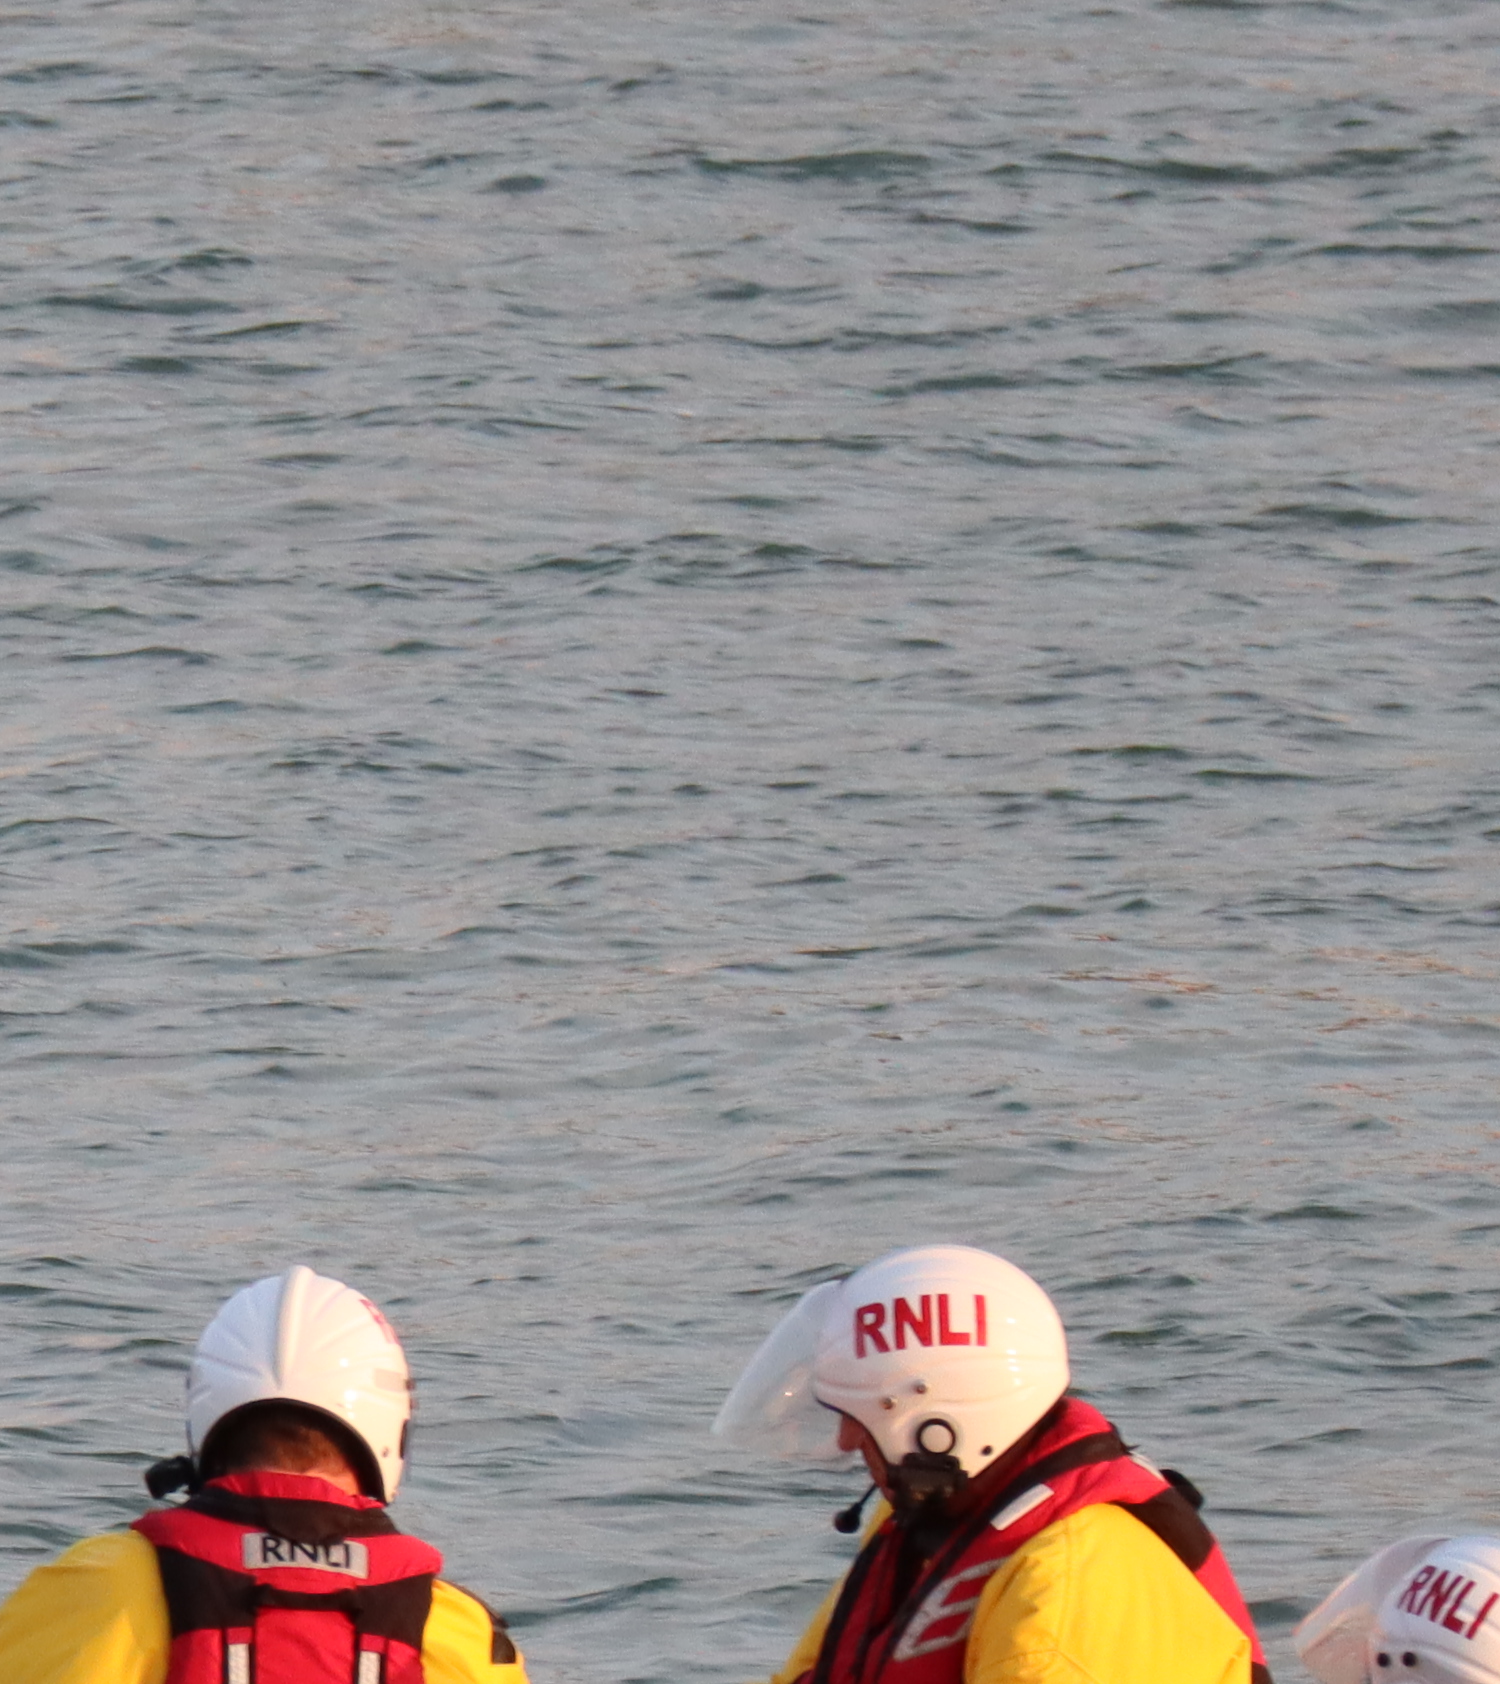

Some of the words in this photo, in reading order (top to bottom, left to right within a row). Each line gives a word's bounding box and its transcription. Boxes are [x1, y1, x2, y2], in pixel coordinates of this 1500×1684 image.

[856, 1290, 987, 1359] RNLI
[261, 1536, 351, 1569] RNLI
[1397, 1565, 1500, 1640] RNLI
